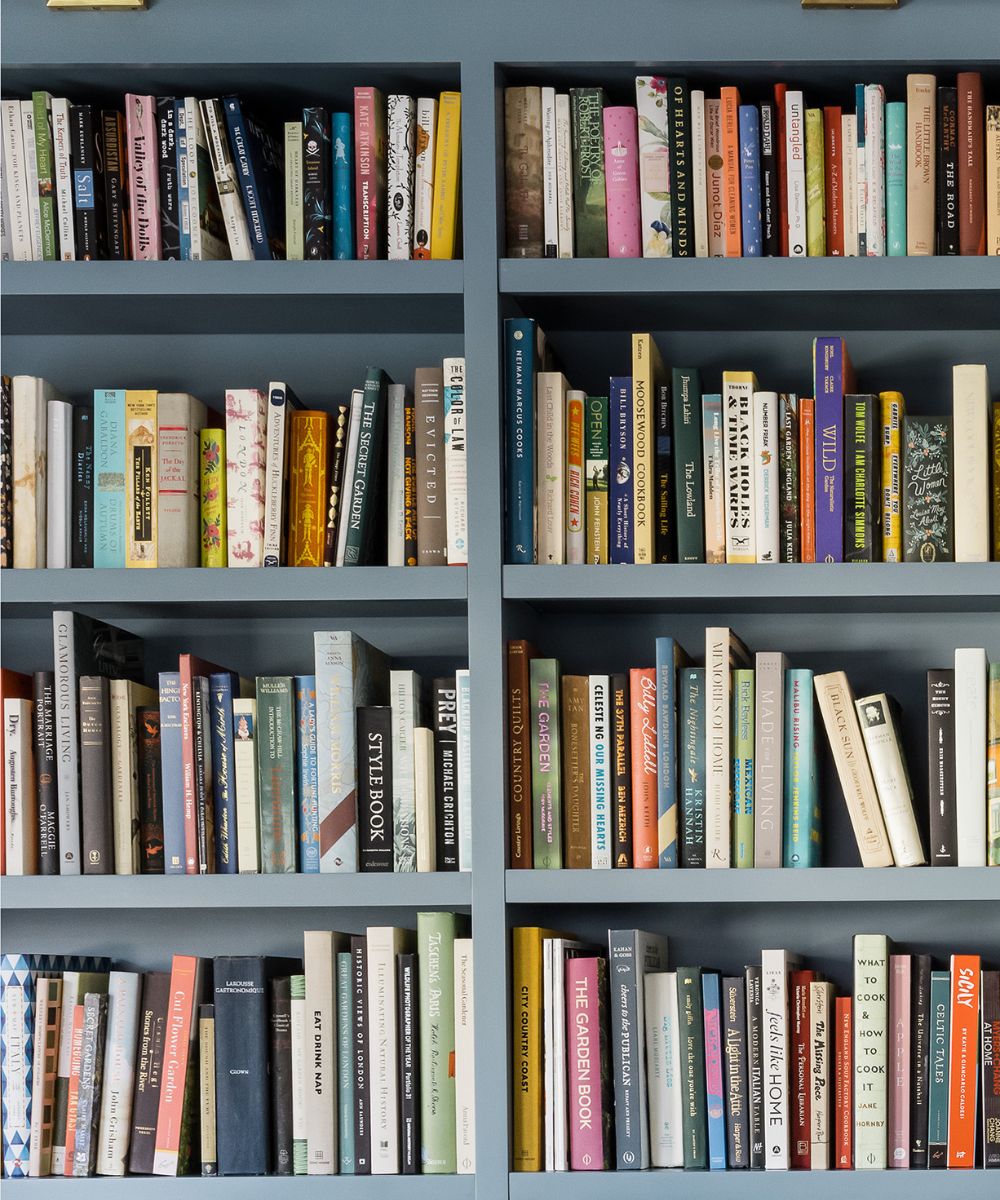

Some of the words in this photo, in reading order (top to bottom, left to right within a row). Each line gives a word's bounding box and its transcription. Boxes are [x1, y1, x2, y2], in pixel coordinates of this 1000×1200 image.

[589, 93, 599, 117] THE
[674, 86, 683, 104] OF
[360, 106, 369, 127] KATE
[579, 96, 591, 138] ROBERT
[790, 104, 802, 160] untangled
[133, 136, 145, 173] Valley
[360, 131, 370, 175] ATKINSON
[590, 122, 601, 164] POETRY
[675, 109, 685, 165] HEARTS
[580, 145, 591, 180] FROST
[923, 155, 931, 183] BROWN
[946, 162, 954, 187] THE
[78, 175, 89, 204] Salt
[136, 176, 147, 190] of
[676, 171, 685, 201] AND
[712, 172, 722, 207] Junot
[137, 194, 147, 214] the
[947, 194, 955, 229] ROAD
[138, 218, 149, 251] Dolls
[678, 207, 687, 256] MINDS
[713, 211, 723, 238] Díaz
[450, 376, 463, 414] COLOR
[728, 395, 737, 409] &
[855, 402, 865, 417] TOM
[363, 402, 375, 428] THE
[590, 400, 603, 440] OPEN
[636, 380, 645, 458] MOOSEWOOD
[740, 395, 750, 459] BLACK
[855, 420, 865, 443] WOLFE
[356, 431, 372, 477] SECRET
[451, 428, 464, 451] LAW
[728, 414, 738, 461] TIME
[822, 424, 836, 471] WILD
[425, 415, 436, 504] EVICTED
[685, 462, 694, 479] The
[856, 454, 865, 466] AM
[350, 479, 365, 530] GARDEN
[637, 463, 646, 527] COOKBOOK
[686, 482, 695, 517] Lowland
[729, 466, 739, 529] WARPS
[740, 465, 750, 529] HOLES
[855, 468, 865, 509] CHARLOTTE
[855, 512, 865, 548] SIMMONS
[58, 624, 70, 710] GLAMOROUS
[44, 685, 52, 706] THE
[438, 689, 456, 734] PREY
[595, 685, 603, 721] CELESTE
[44, 709, 53, 761] MARRIAGE
[61, 716, 71, 763] LIVING
[595, 726, 603, 740] NG
[368, 733, 383, 786] STYLE
[443, 750, 454, 792] MICHAEL
[595, 744, 604, 765] OUR
[596, 768, 605, 810] MISSING
[39, 804, 47, 857] O'FARRELL
[47, 811, 55, 850] MAGGIE
[370, 792, 384, 841] BOOK
[444, 796, 454, 845] CRICHTON
[597, 814, 605, 850] HEARTS
[685, 788, 694, 845] HANNAH
[695, 789, 703, 843] KRISTIN
[575, 977, 588, 1009] THE
[957, 968, 974, 1008] SICILY
[314, 1011, 322, 1031] EAT
[766, 1009, 783, 1042] feels
[936, 1004, 945, 1044] CELTIC
[984, 1022, 992, 1034] AT
[314, 1034, 322, 1068] DRINK
[576, 1012, 589, 1081] GARDEN
[770, 1045, 784, 1071] like
[984, 1036, 992, 1065] HOME
[314, 1072, 322, 1095] NAP
[935, 1048, 945, 1083] TALES
[578, 1085, 591, 1130] BOOK
[769, 1074, 782, 1126] HOME
